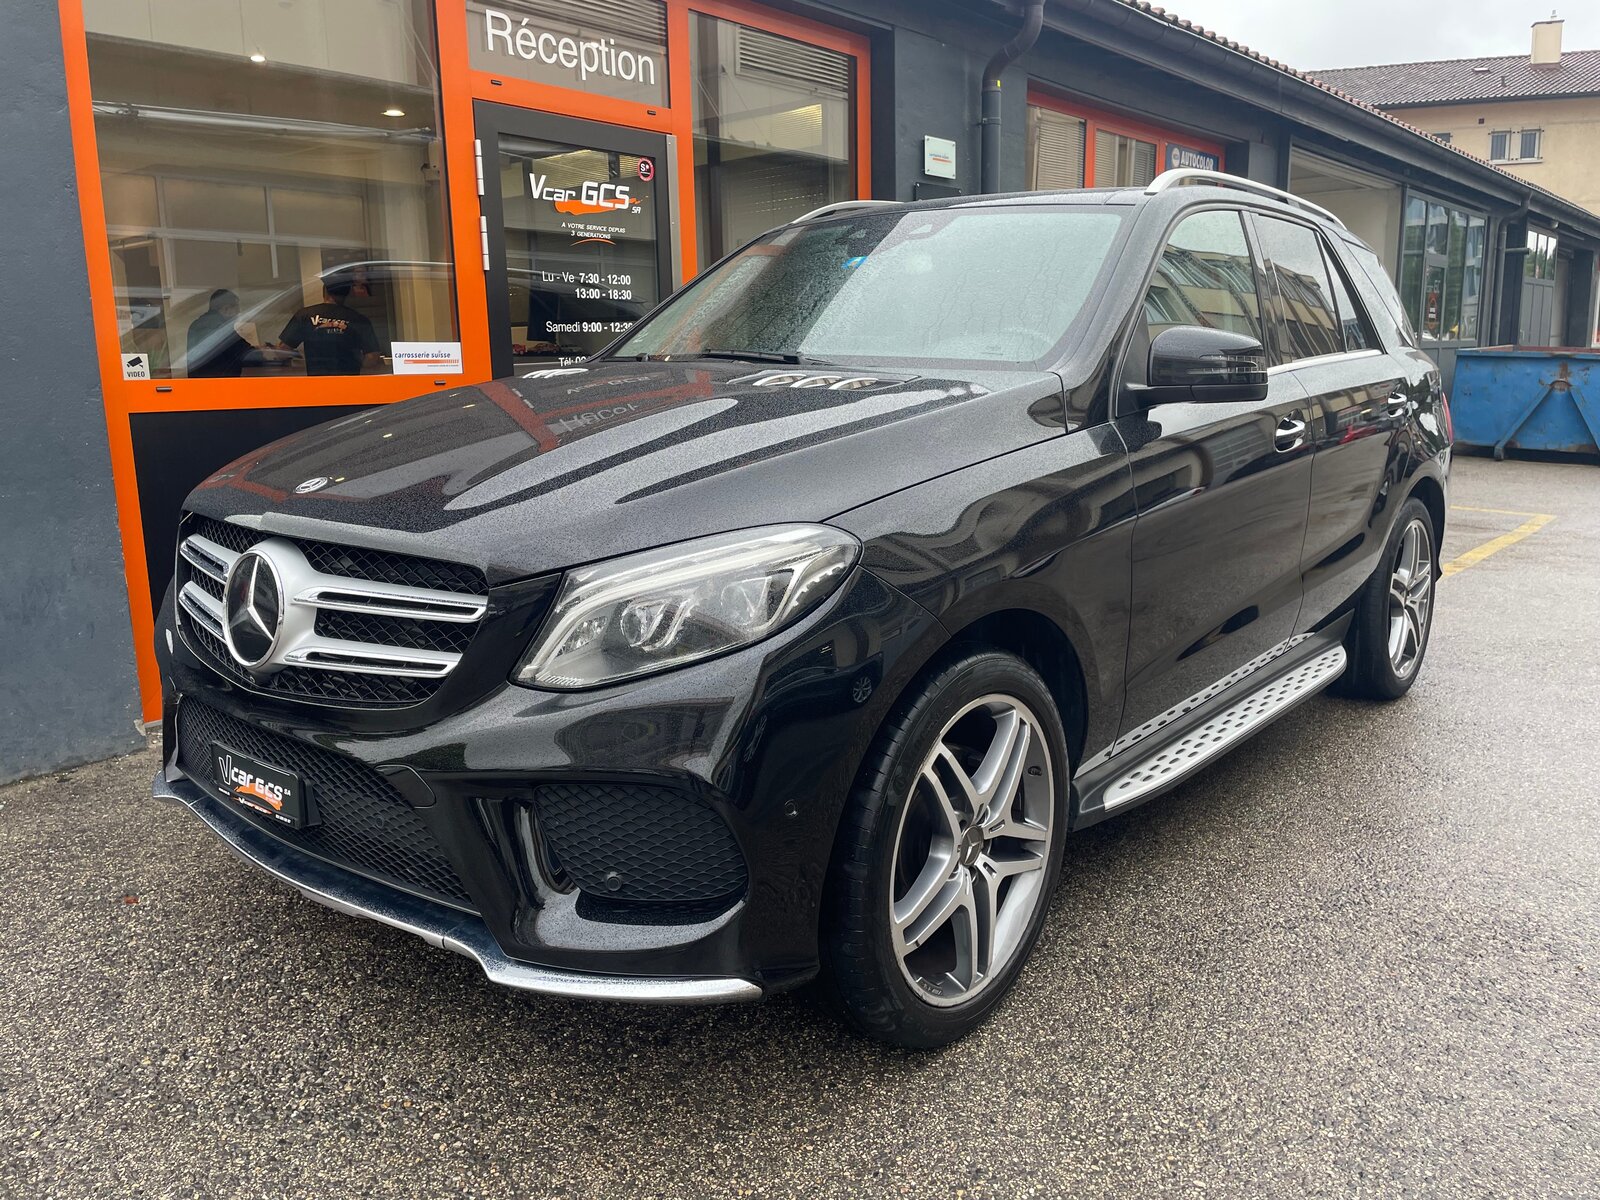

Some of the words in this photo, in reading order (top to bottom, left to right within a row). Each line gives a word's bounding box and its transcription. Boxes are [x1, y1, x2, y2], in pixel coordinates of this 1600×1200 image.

[485, 9, 655, 85] Réception
[1180, 150, 1214, 171] AUTOCOLOR
[529, 173, 576, 202] Vcar
[581, 181, 630, 210] GCS
[542, 271, 555, 282] Lu
[562, 272, 575, 283] Ve
[579, 273, 599, 284] 7:30
[607, 274, 631, 285] 12:00
[575, 288, 600, 299] 13:00
[608, 290, 632, 300] 18:30
[545, 320, 581, 333] Samedi
[582, 322, 602, 333] 9:00
[431, 350, 451, 358] suisse
[218, 754, 254, 788] Vcar
[255, 777, 284, 801] GCS
